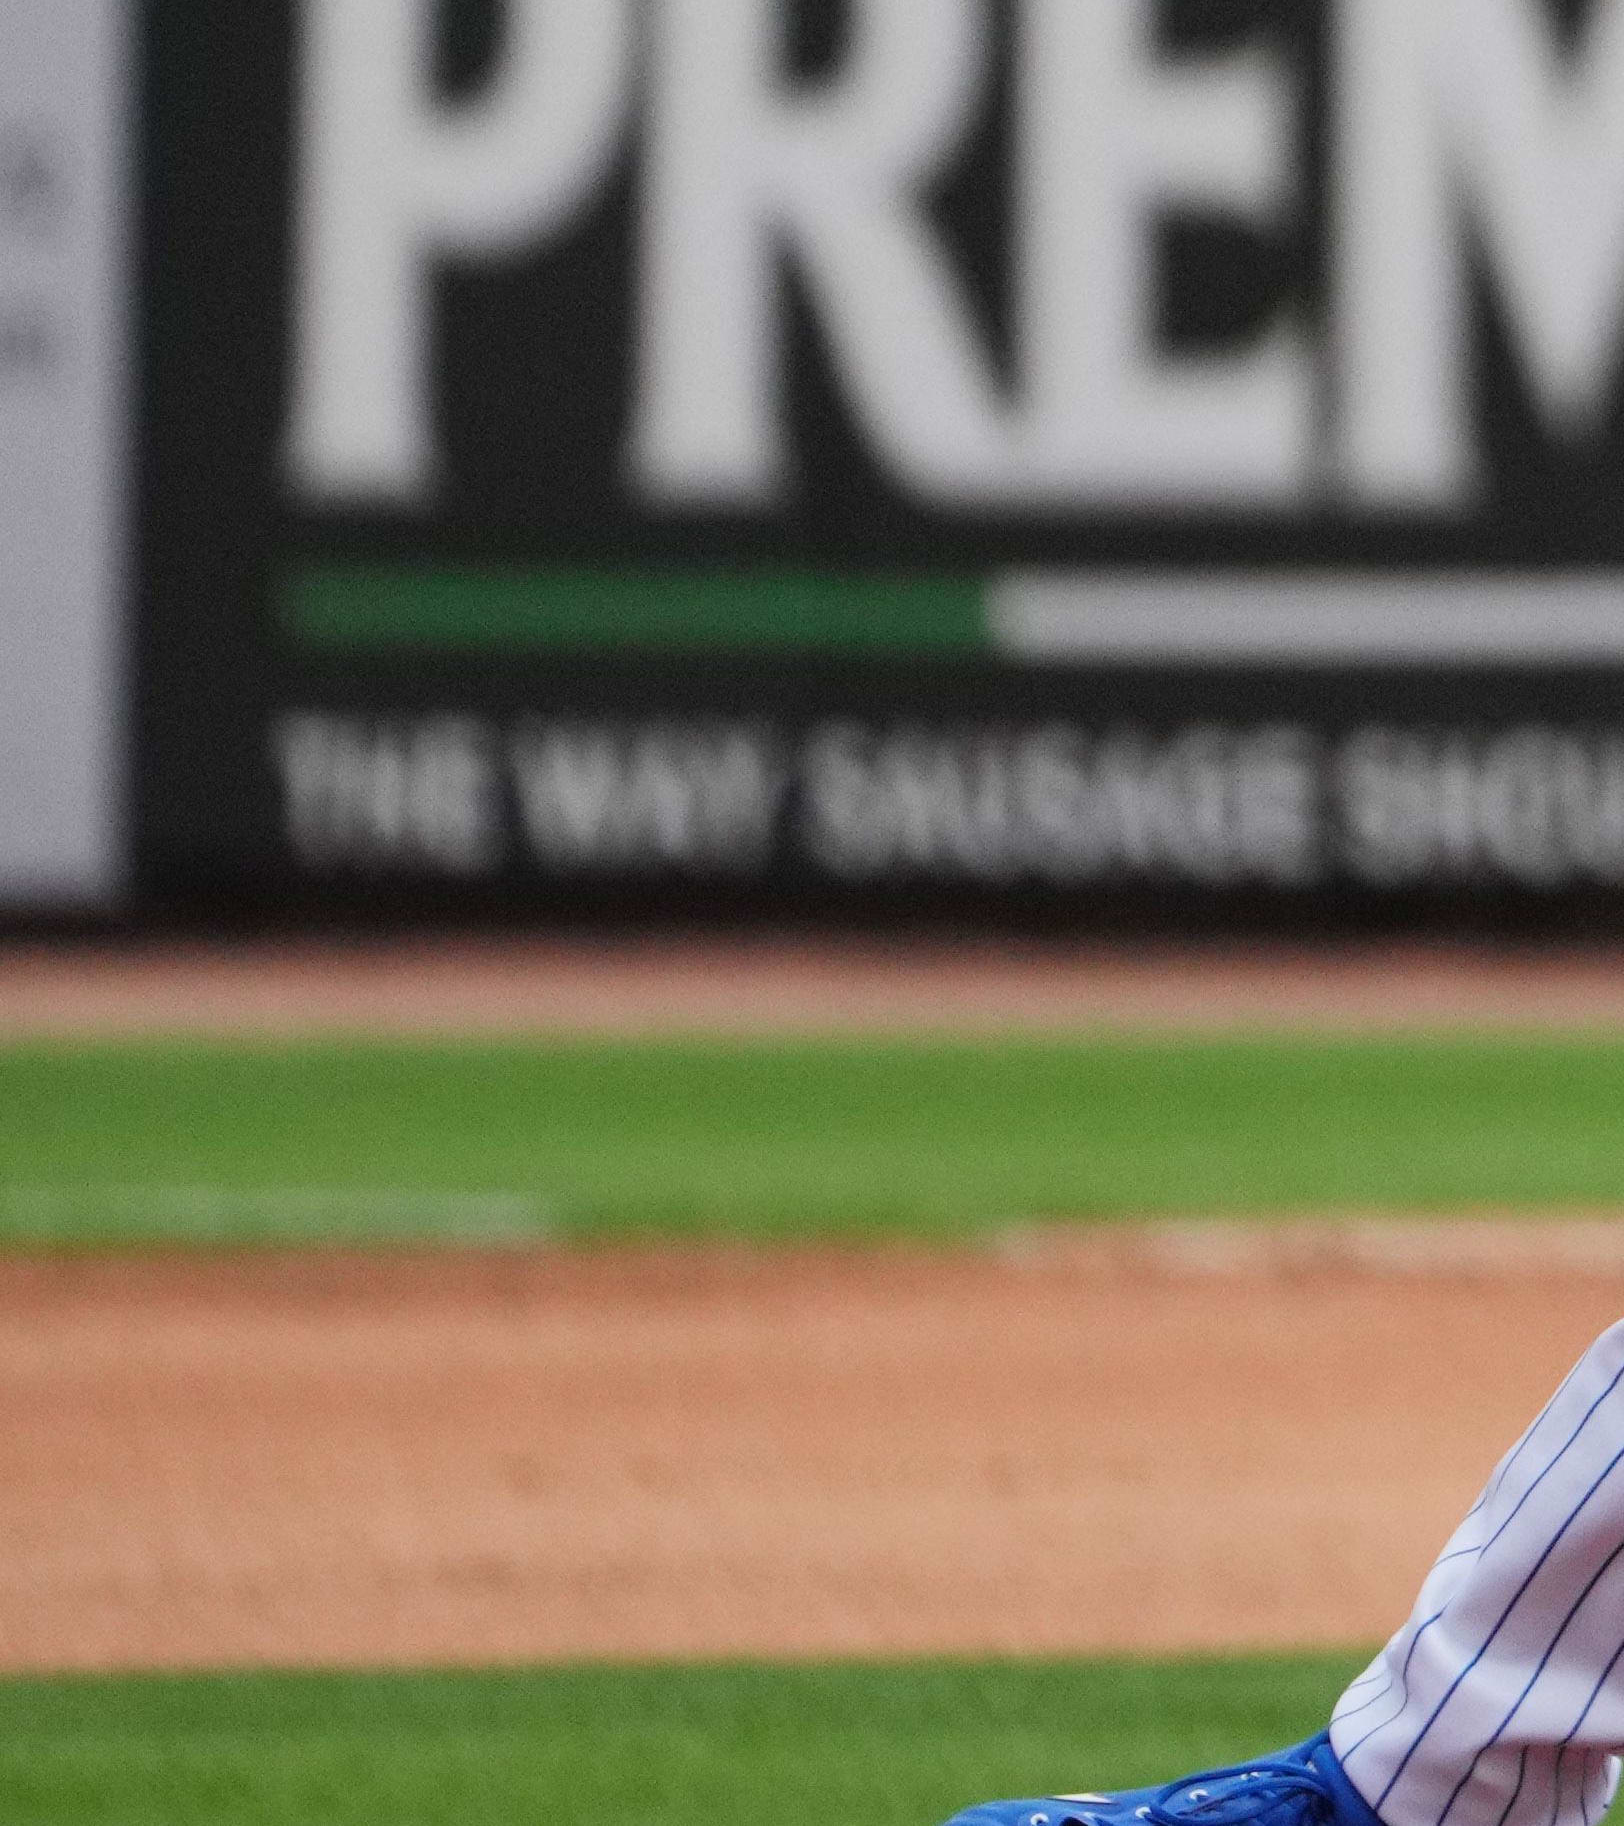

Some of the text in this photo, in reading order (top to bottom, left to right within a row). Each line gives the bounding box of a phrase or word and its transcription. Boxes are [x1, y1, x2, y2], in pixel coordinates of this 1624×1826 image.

[276, 722, 492, 878] THE
[516, 722, 778, 878] WAY
[795, 722, 1316, 880] SAUSAGE
